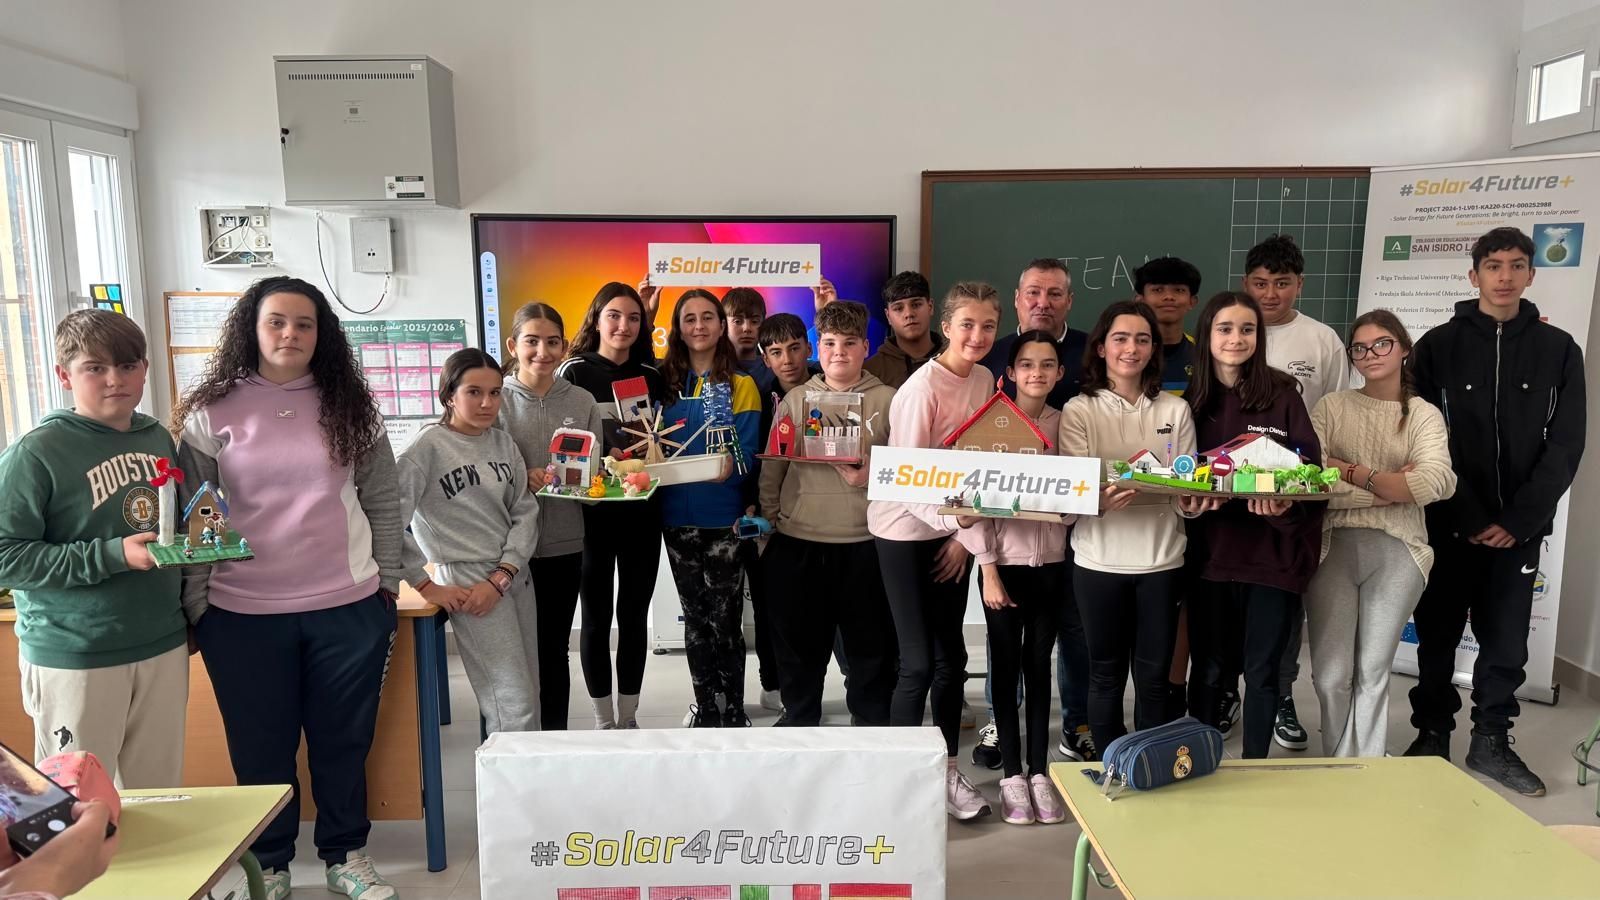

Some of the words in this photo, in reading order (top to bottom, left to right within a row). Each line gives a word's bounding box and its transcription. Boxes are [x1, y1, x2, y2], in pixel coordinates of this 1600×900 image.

[1400, 174, 1575, 196] #Solar4Future+
[1408, 214, 1426, 223] Energy
[1436, 212, 1455, 220] Future
[1543, 208, 1559, 216] solar
[1559, 208, 1580, 217] power
[1415, 206, 1441, 214] PROJECT
[1412, 244, 1430, 253] SAN
[1432, 243, 1463, 252] ISIDRO
[656, 257, 814, 274] #Solar4Future+
[344, 324, 379, 332] endario
[403, 322, 456, 333] 2025/2026
[1247, 424, 1269, 434] Design
[1269, 426, 1288, 437] District
[439, 464, 480, 500] NEW
[877, 464, 1090, 497] #Solar4Future+
[531, 830, 895, 867] #Solar4Future+
